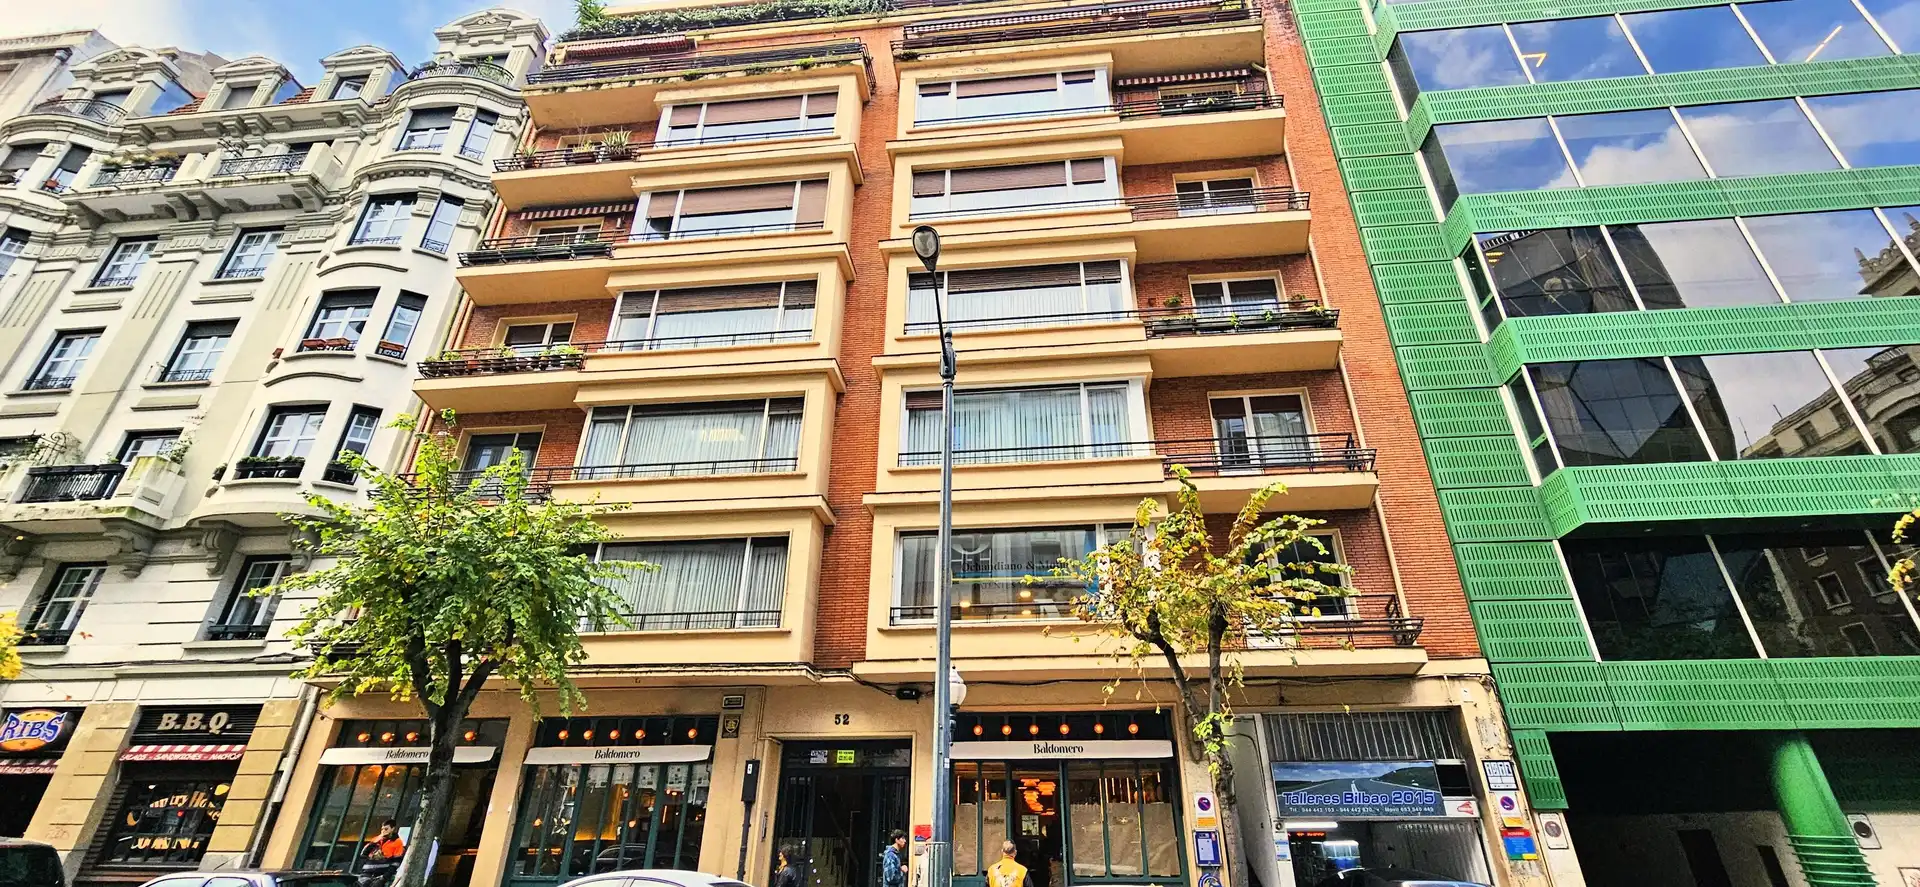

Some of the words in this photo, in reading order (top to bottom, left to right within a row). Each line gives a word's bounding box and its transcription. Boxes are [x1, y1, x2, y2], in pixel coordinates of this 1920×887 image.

[157, 712, 233, 735] B.B.Q.
[834, 713, 850, 725] 52
[0, 712, 68, 743] RIBS
[386, 749, 429, 759] Baldomero
[594, 748, 641, 759] Baldomero
[1033, 741, 1084, 754] Baldomero
[1283, 792, 1340, 804] Talleres
[1342, 791, 1388, 804] Bilbao
[1391, 791, 1435, 804] 2015
